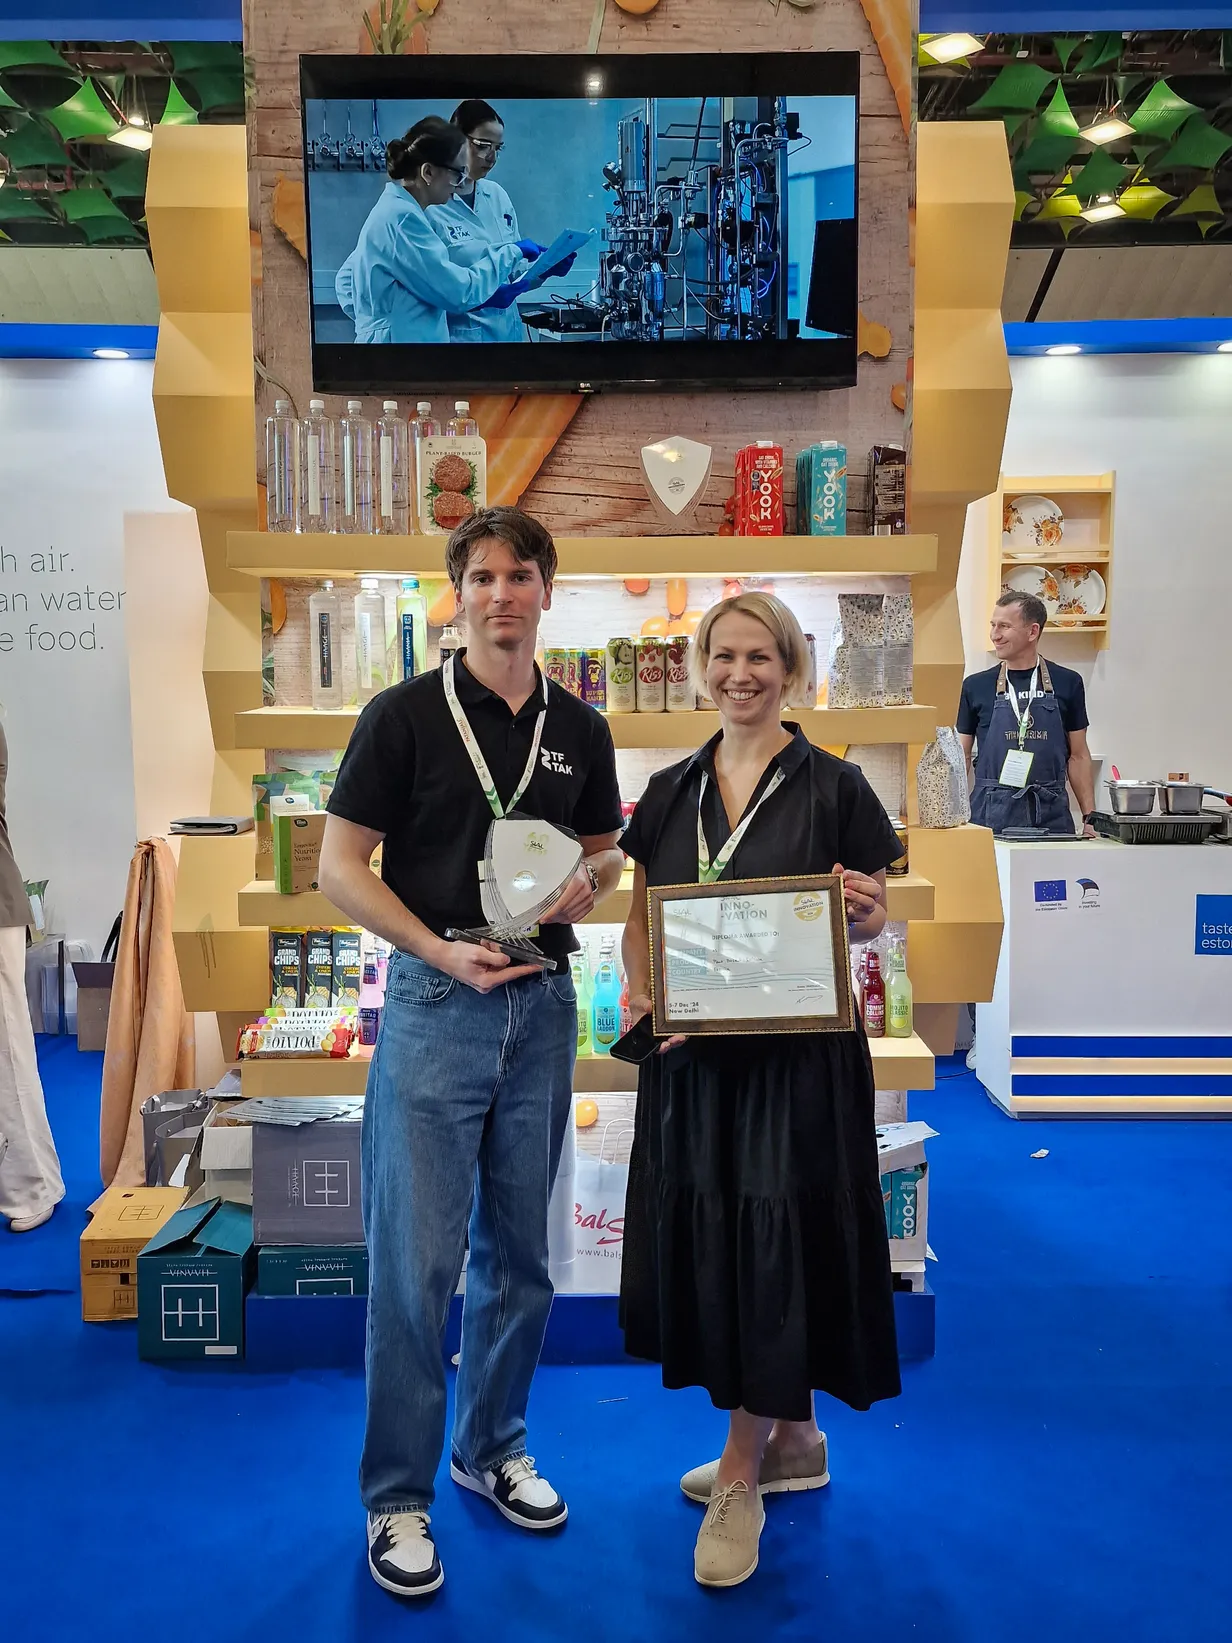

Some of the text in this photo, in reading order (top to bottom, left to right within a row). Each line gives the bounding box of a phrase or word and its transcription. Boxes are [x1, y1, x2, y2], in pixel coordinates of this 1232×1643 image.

[760, 470, 773, 520] YOOK
[823, 469, 836, 520] YOOK
[30, 545, 75, 573] air.
[40, 584, 127, 612] water
[25, 622, 104, 652] food.
[612, 667, 633, 684] Kiss
[639, 667, 662, 684] Kiss
[551, 751, 565, 762] TF
[552, 762, 574, 777] TAK
[307, 955, 333, 965] CHIPS
[311, 948, 331, 956] GRAND
[274, 955, 300, 966] CHIPS
[335, 956, 361, 966] CHIPS
[597, 1018, 615, 1027] BLUE
